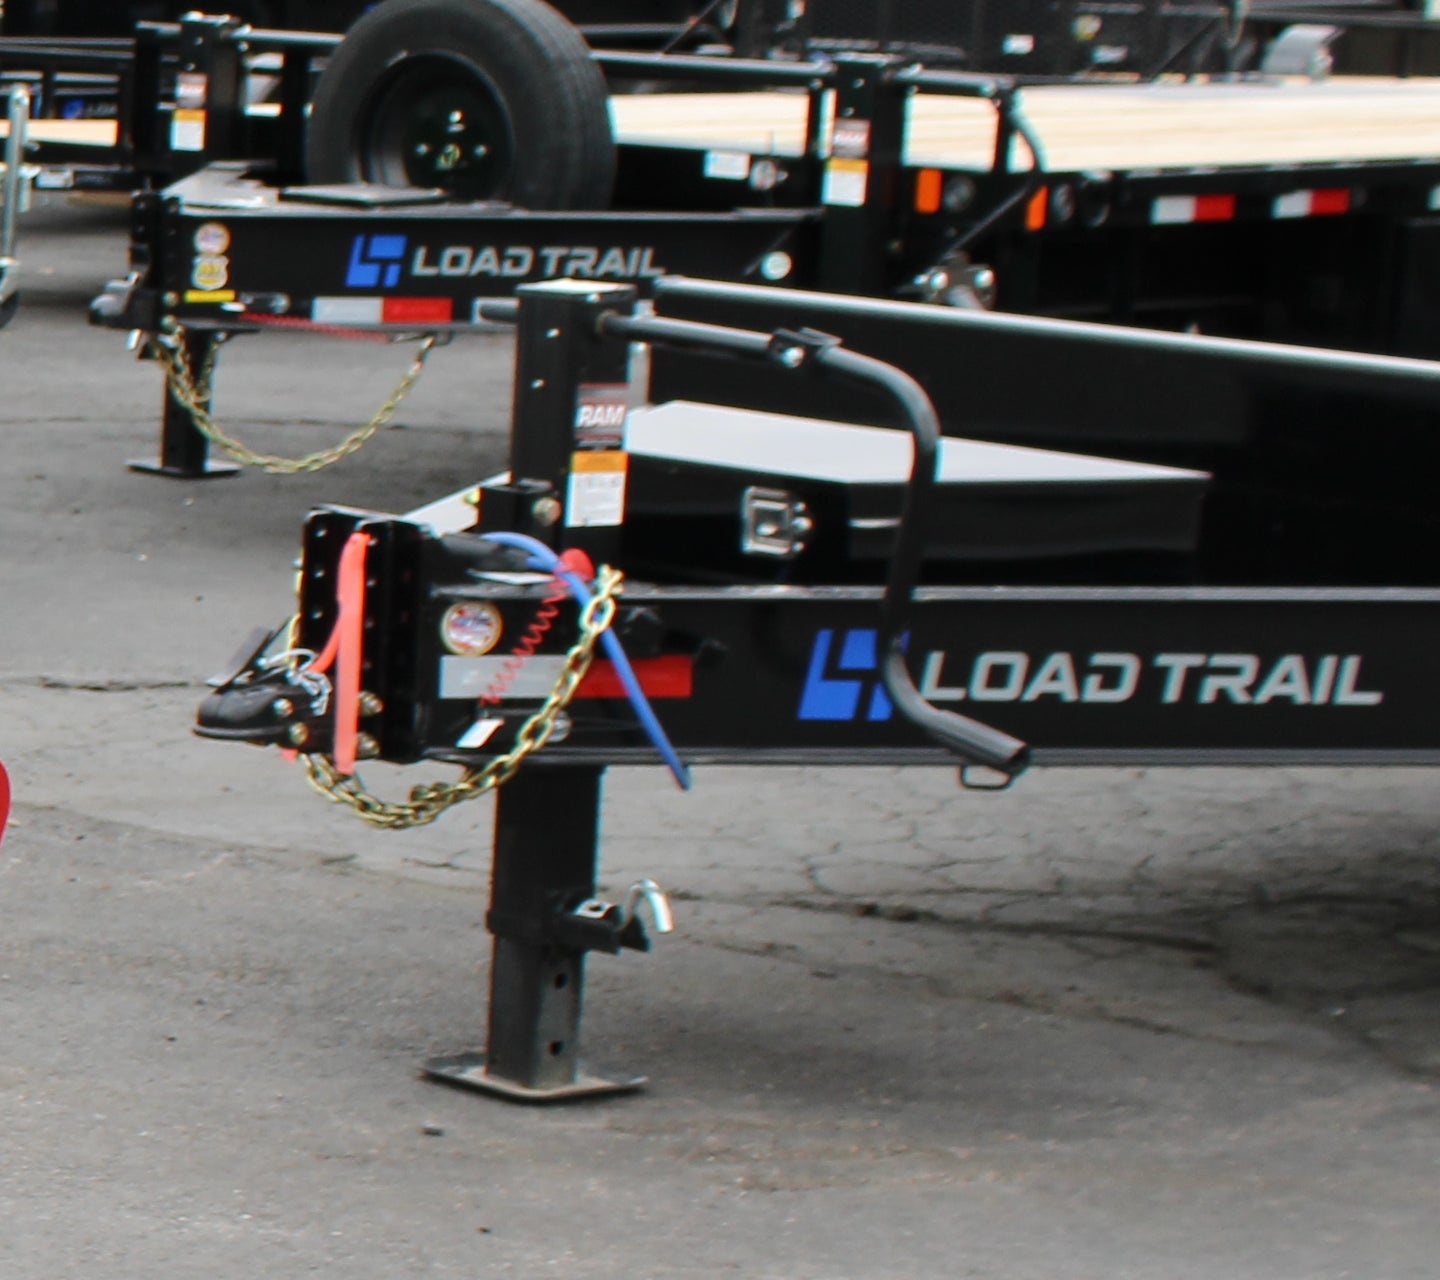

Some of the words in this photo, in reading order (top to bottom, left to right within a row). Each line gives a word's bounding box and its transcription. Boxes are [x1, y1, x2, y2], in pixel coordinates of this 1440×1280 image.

[410, 245, 535, 277] LOAD
[537, 245, 667, 278] TRAIL
[919, 650, 1142, 703] LOAD
[1153, 653, 1384, 705] TRAIL
